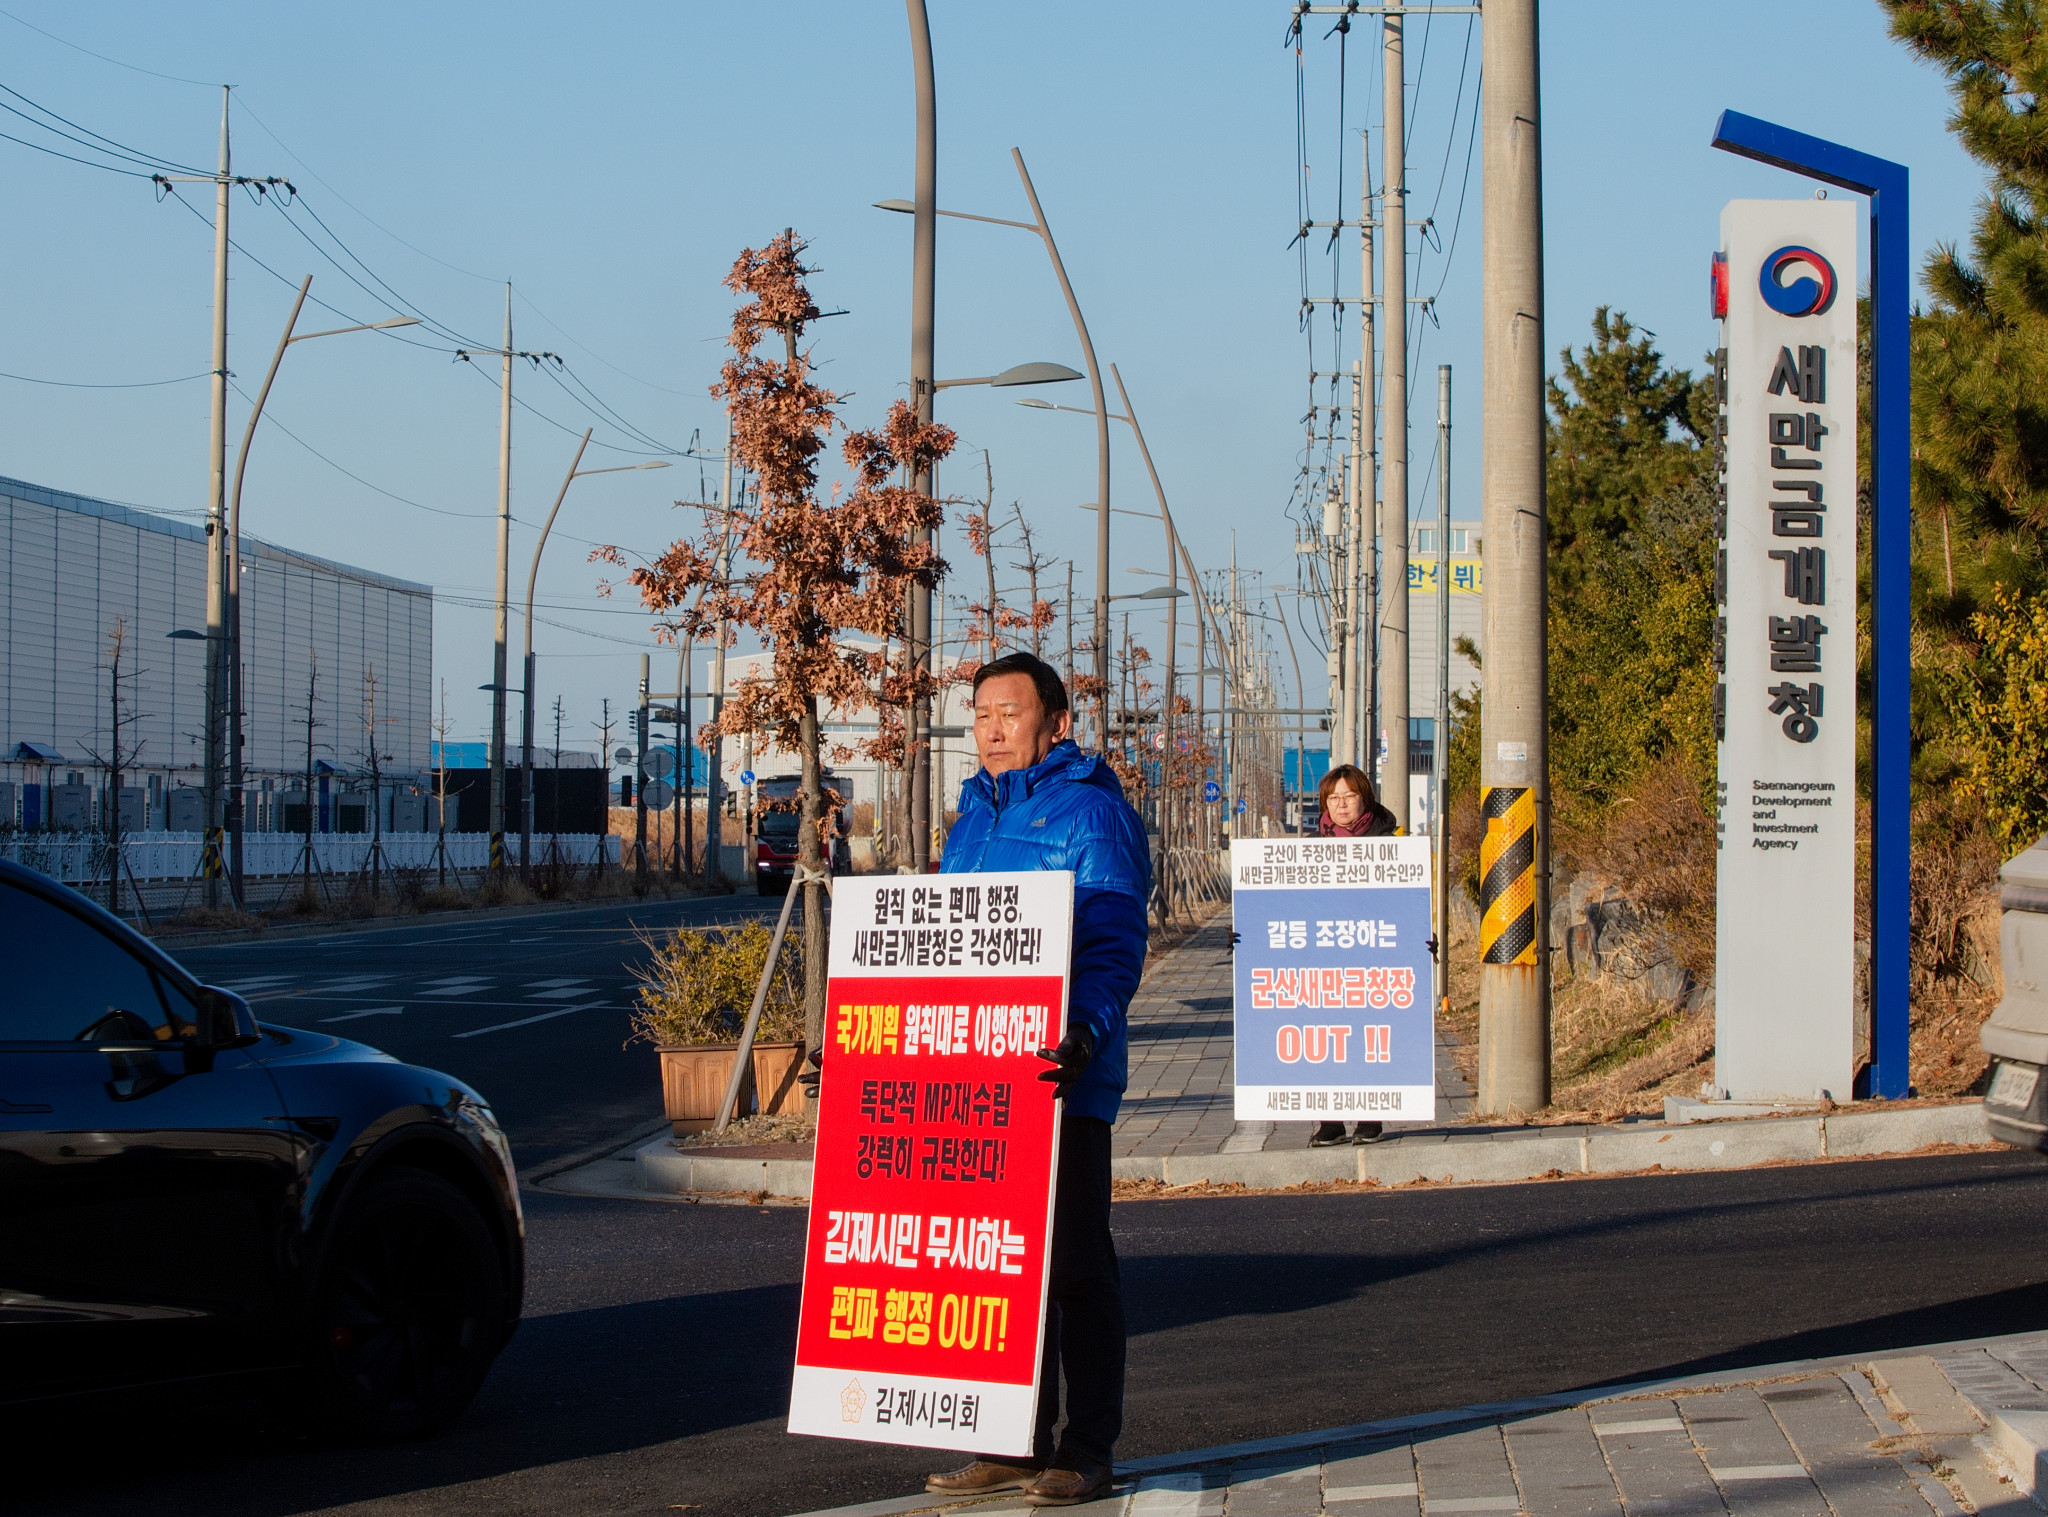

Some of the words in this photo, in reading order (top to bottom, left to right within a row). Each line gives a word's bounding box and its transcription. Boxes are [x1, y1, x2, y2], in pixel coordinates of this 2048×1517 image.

[1767, 345, 1827, 743] 새만금개발청
[1752, 780, 1835, 793] Saemangeum
[1752, 795, 1832, 808] Development
[1752, 809, 1776, 819] and
[1753, 822, 1818, 833] Investment
[1264, 845, 1297, 863] 군산이
[1302, 844, 1347, 863] 주장하면
[1352, 843, 1375, 862] 즉시
[1379, 843, 1398, 862] OK!
[1752, 837, 1798, 850] Agency
[1240, 866, 1331, 885] 새만금개발청장은
[1335, 865, 1369, 884] 군산의
[1375, 864, 1424, 883] 하수인??
[875, 888, 905, 925] 원칙
[912, 887, 942, 925] 없는
[949, 886, 981, 923] 편파
[987, 885, 1022, 923] 행정,
[852, 929, 964, 967] 새만금개발청은
[970, 928, 1042, 966] 각성하라!
[1267, 920, 1307, 949] 갈등
[1316, 920, 1397, 948] 조장하는
[1251, 967, 1415, 1009] 군산새만금청장
[837, 1004, 900, 1054] 국가계획
[904, 1004, 969, 1056] 원칙대로
[975, 1004, 1048, 1057] 이행하라!
[1276, 1025, 1351, 1063] OUT
[1364, 1025, 1391, 1063] !!
[861, 1081, 917, 1124] 독단적
[923, 1082, 1011, 1127] MP재수립
[1267, 1092, 1300, 1111] 새만금
[1306, 1091, 1328, 1110] 미래
[1332, 1090, 1402, 1111] 김제시민연대
[857, 1135, 914, 1179] 강력히
[921, 1137, 1007, 1183] 규탄한다!
[825, 1211, 921, 1268] 김제시민
[926, 1216, 1025, 1275] 무시하는
[829, 1286, 878, 1339] 편파
[883, 1289, 933, 1345] 행정
[939, 1294, 1008, 1352] OUT!
[875, 1386, 979, 1432] 김제시의회
